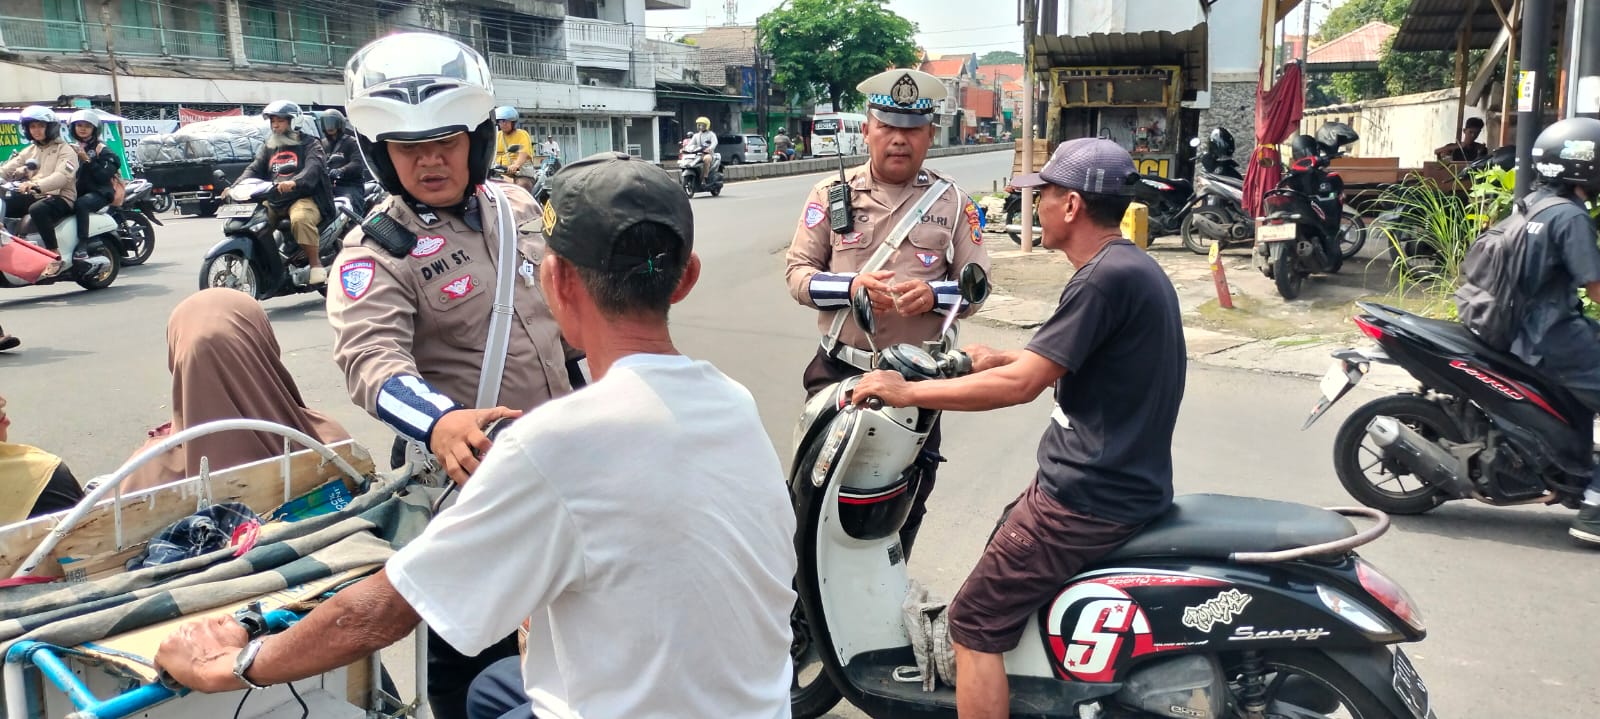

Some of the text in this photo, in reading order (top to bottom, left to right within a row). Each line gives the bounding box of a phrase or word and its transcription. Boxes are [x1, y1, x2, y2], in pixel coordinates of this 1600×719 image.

[124, 125, 158, 134] DIJUAL
[921, 214, 947, 225] OLRI
[421, 257, 450, 281] DWI
[1228, 626, 1331, 641] Scoopy
